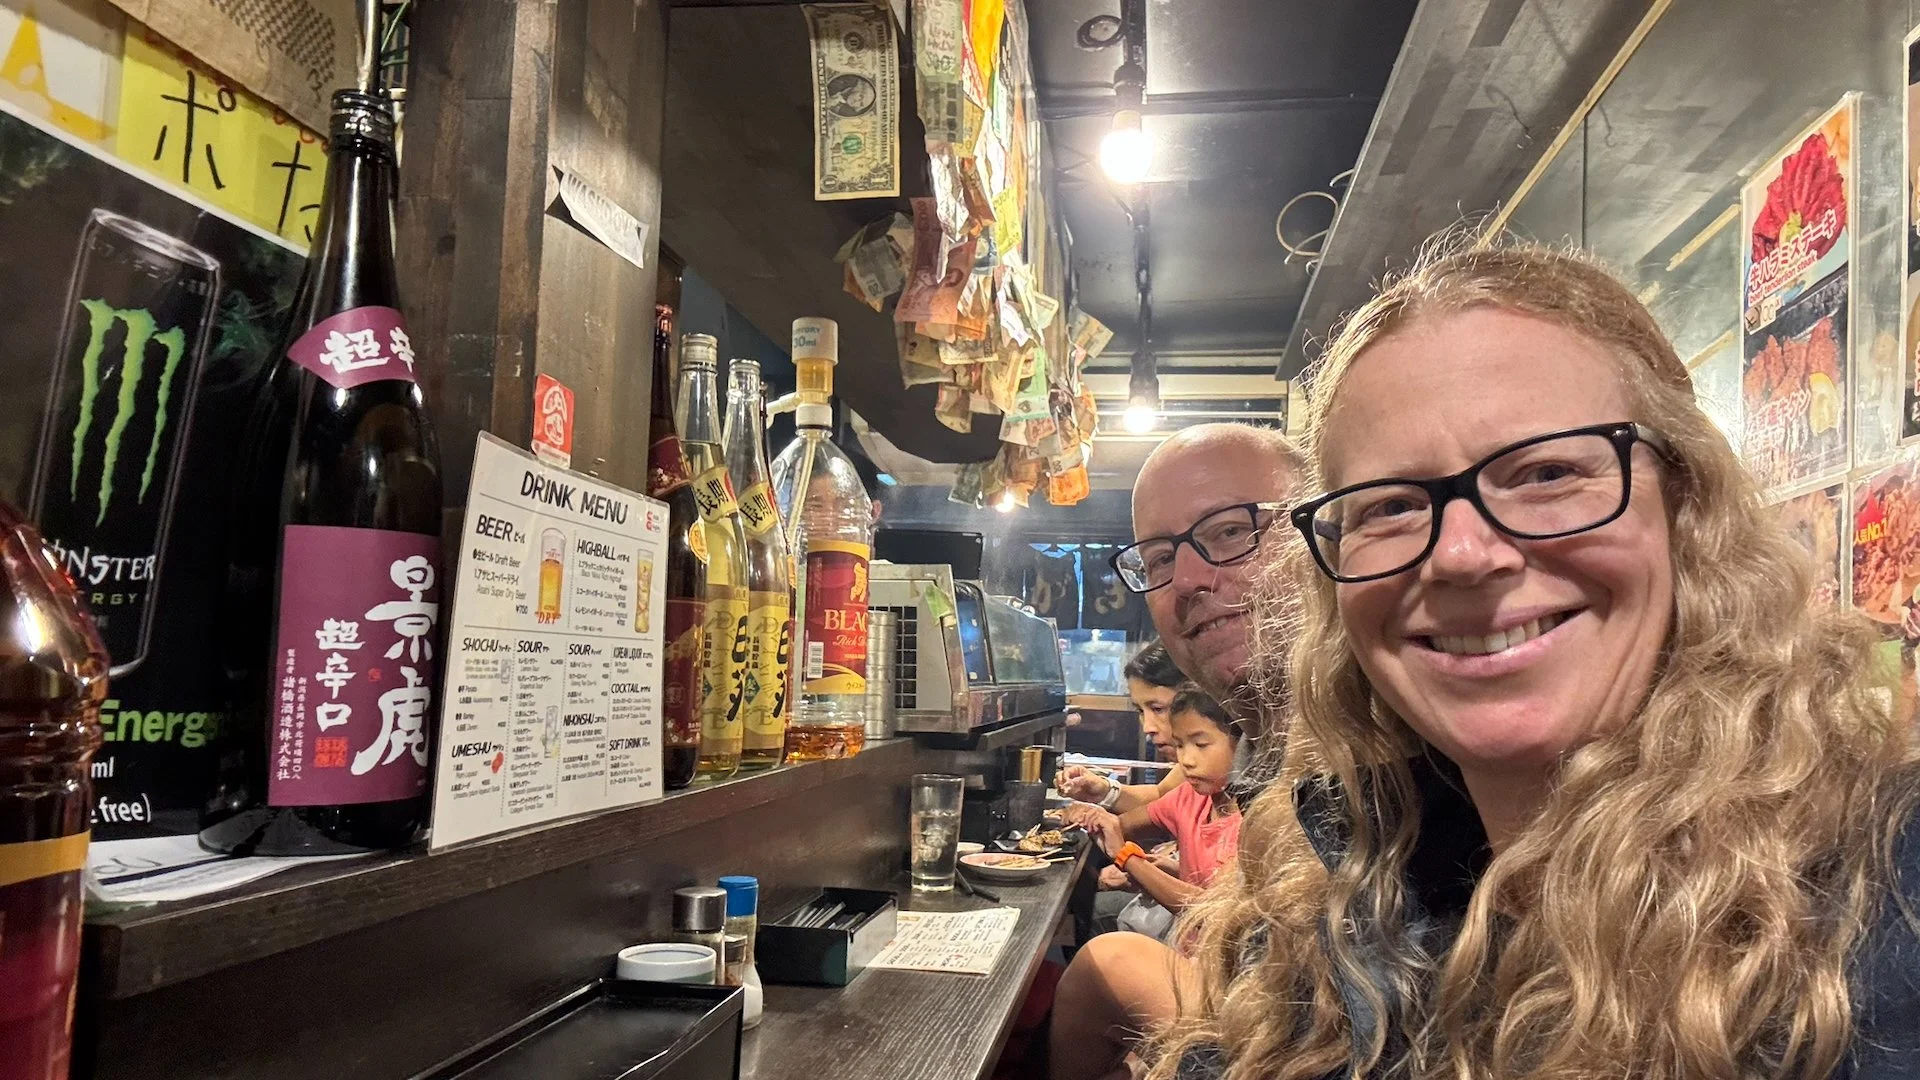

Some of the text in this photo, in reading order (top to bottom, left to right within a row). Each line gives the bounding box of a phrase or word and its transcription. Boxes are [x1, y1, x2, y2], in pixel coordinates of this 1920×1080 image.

[520, 470, 576, 512] DRINK
[580, 491, 629, 525] MENU
[475, 514, 513, 542] BEER
[576, 538, 616, 561] HIGHBALL
[462, 637, 499, 652] SHOCHU
[517, 640, 543, 653] SOUR
[568, 643, 591, 656] SOUR
[314, 617, 366, 733] 超辛口
[611, 682, 639, 694] COCKTAIL
[100, 699, 212, 748] Energ
[452, 741, 492, 758] UMESHU
[608, 736, 641, 751] SOFT DRINK
[99, 792, 152, 823] free)
